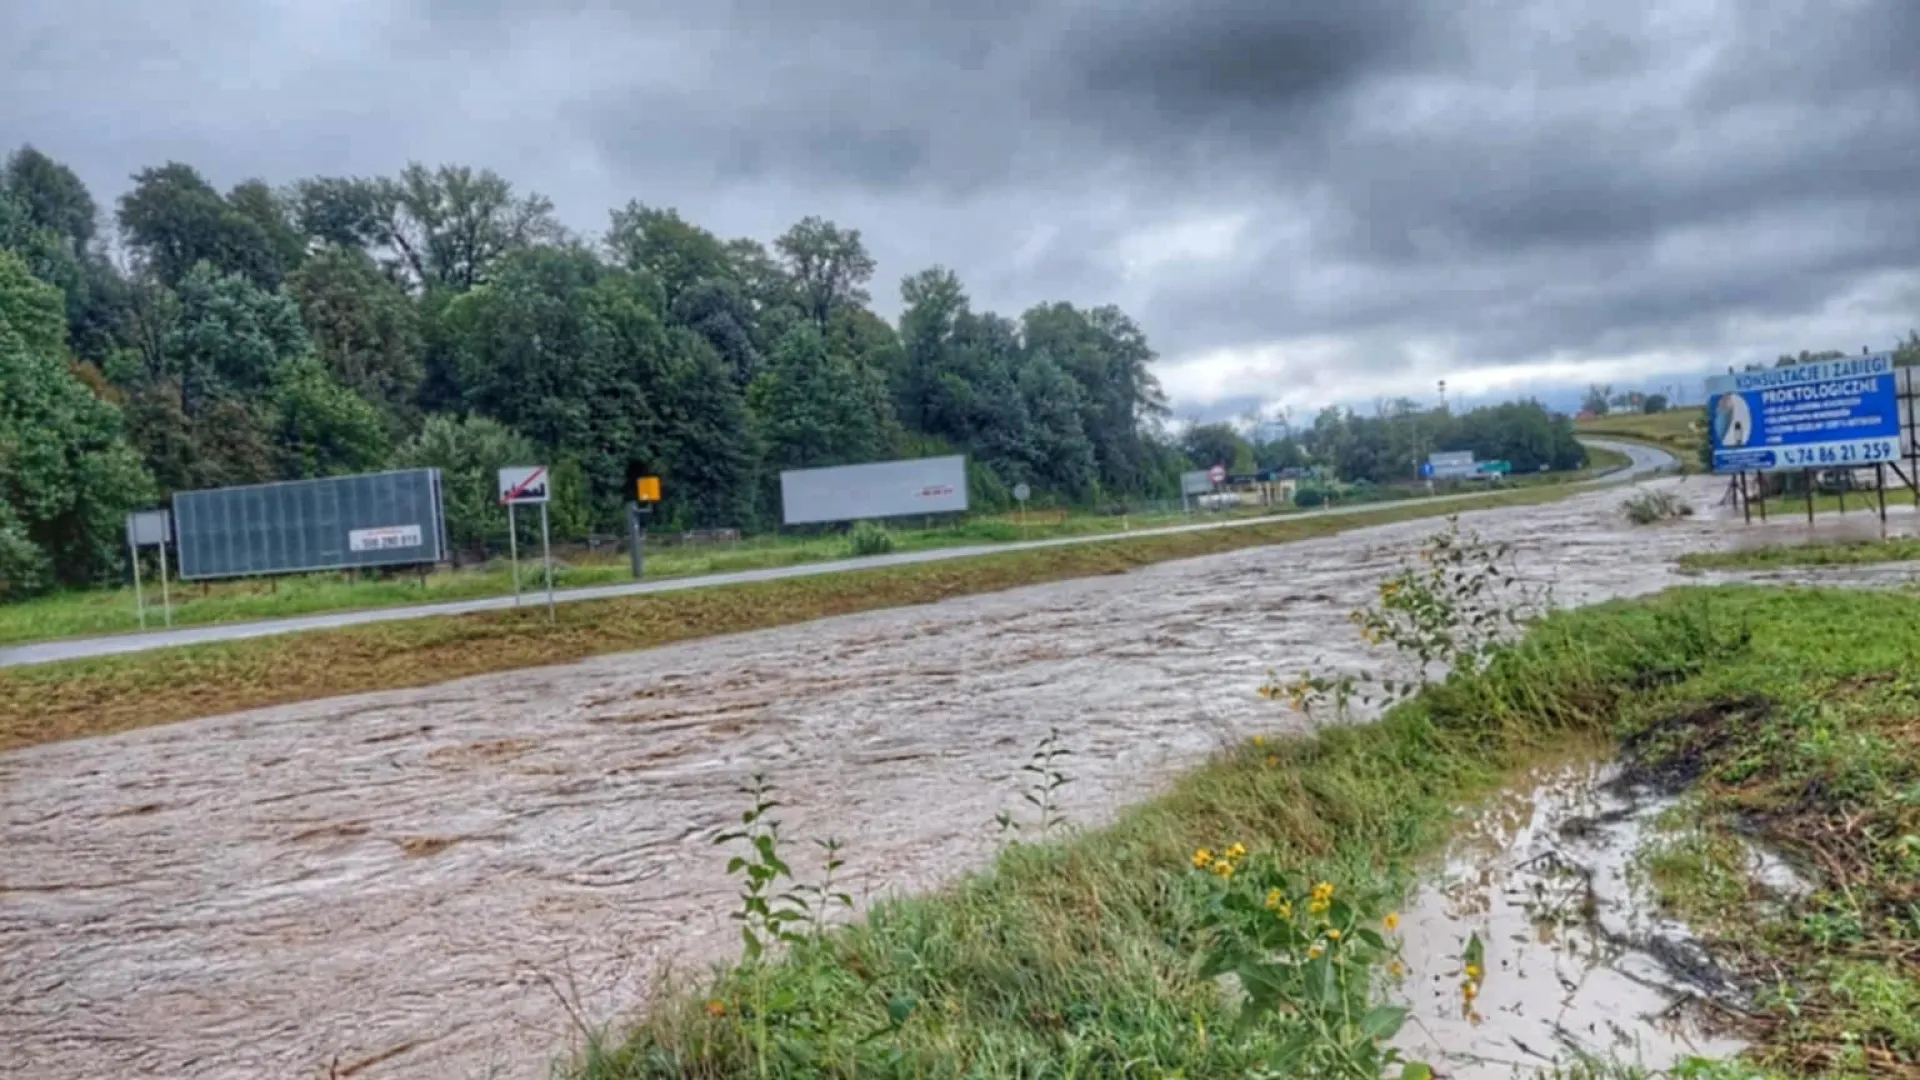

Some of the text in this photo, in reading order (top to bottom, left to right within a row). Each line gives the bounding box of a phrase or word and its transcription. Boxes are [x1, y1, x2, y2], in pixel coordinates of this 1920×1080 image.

[1736, 367, 1818, 387] KONSULTACJE
[1834, 358, 1887, 377] ZABIEGI
[1763, 379, 1878, 403] PROKTOLOGICZNE
[1798, 442, 1891, 463] 74 86 21 259
